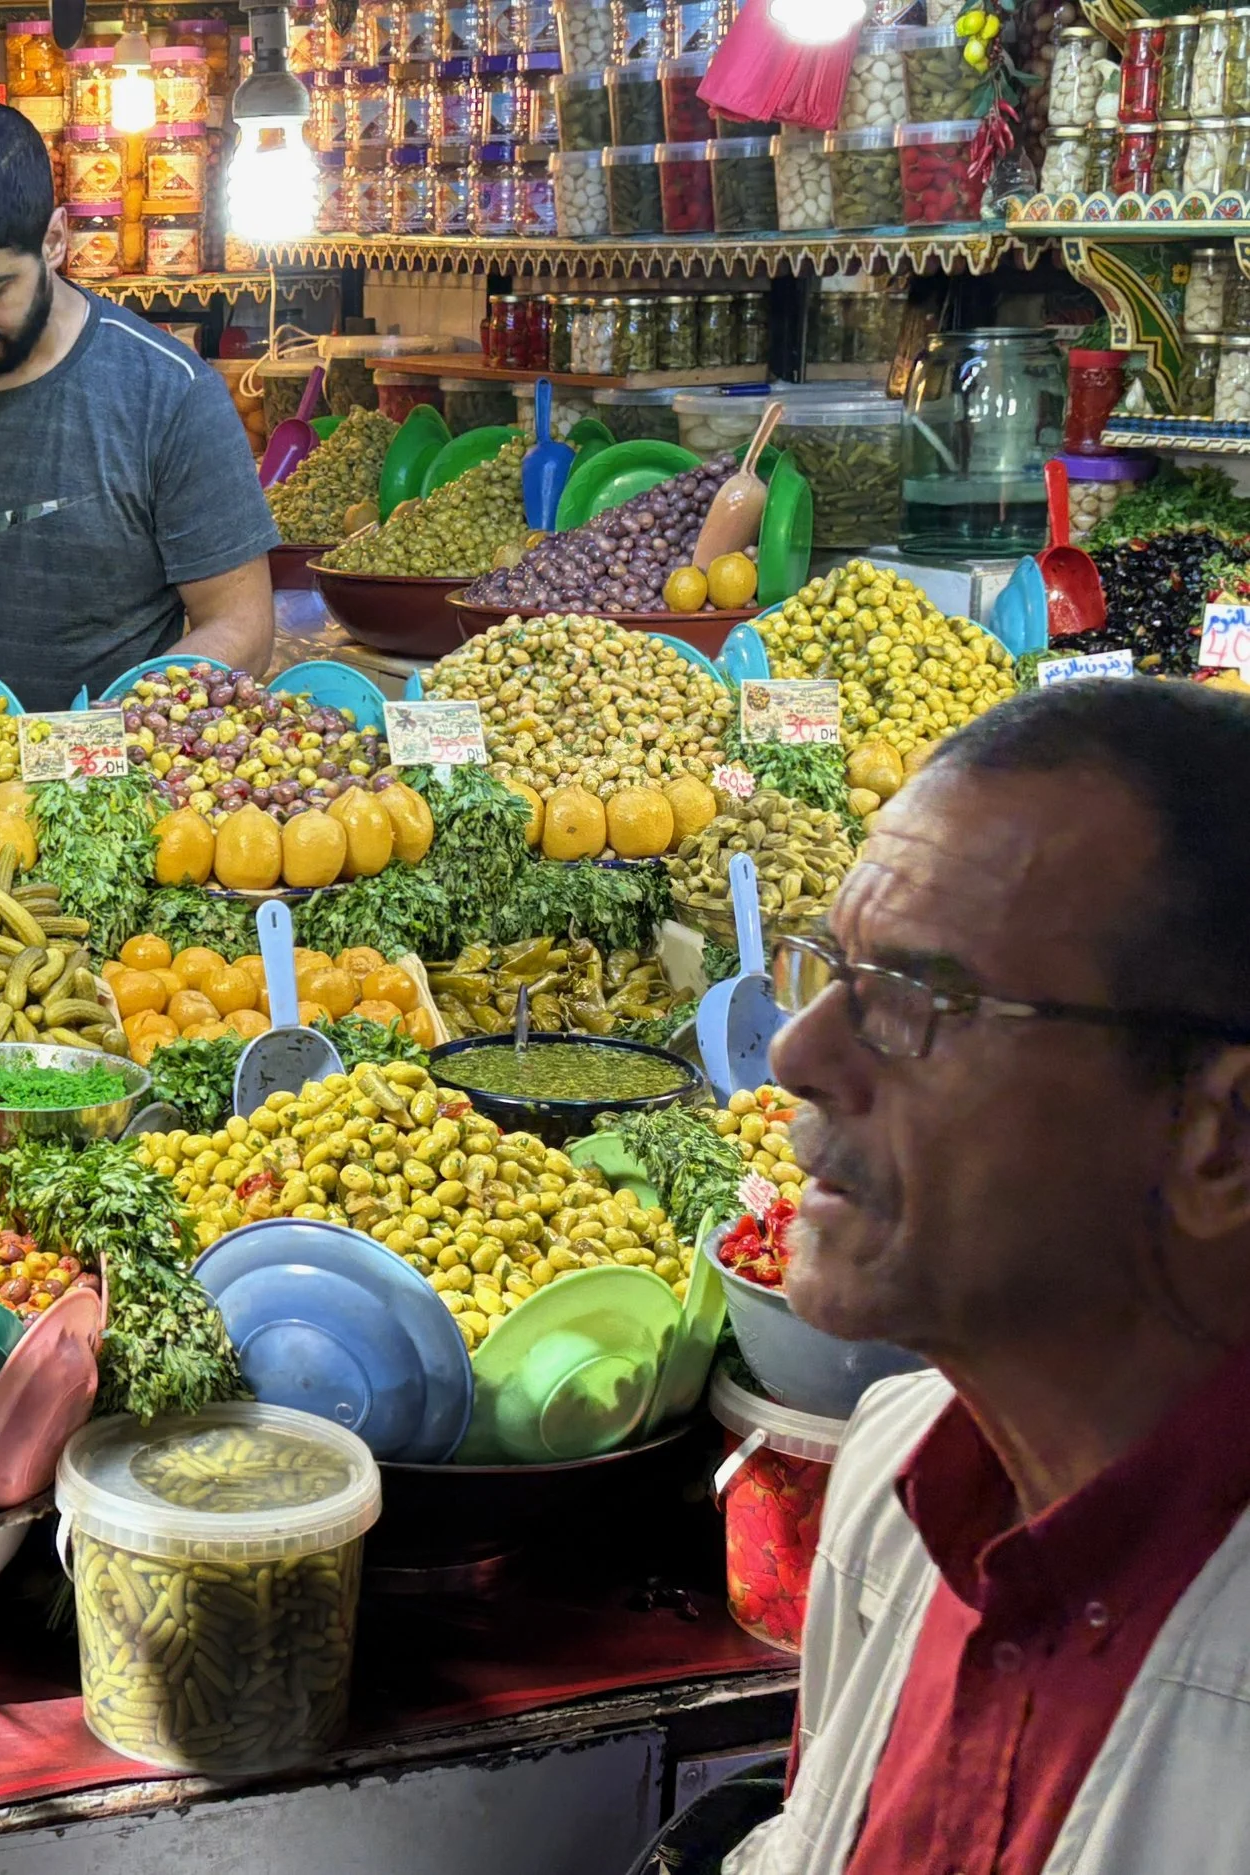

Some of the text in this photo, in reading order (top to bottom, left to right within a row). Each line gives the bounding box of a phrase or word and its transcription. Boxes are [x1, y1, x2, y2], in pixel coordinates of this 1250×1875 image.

[820, 728, 838, 740] DH
[467, 747, 485, 760] DH
[106, 760, 125, 773] DH
